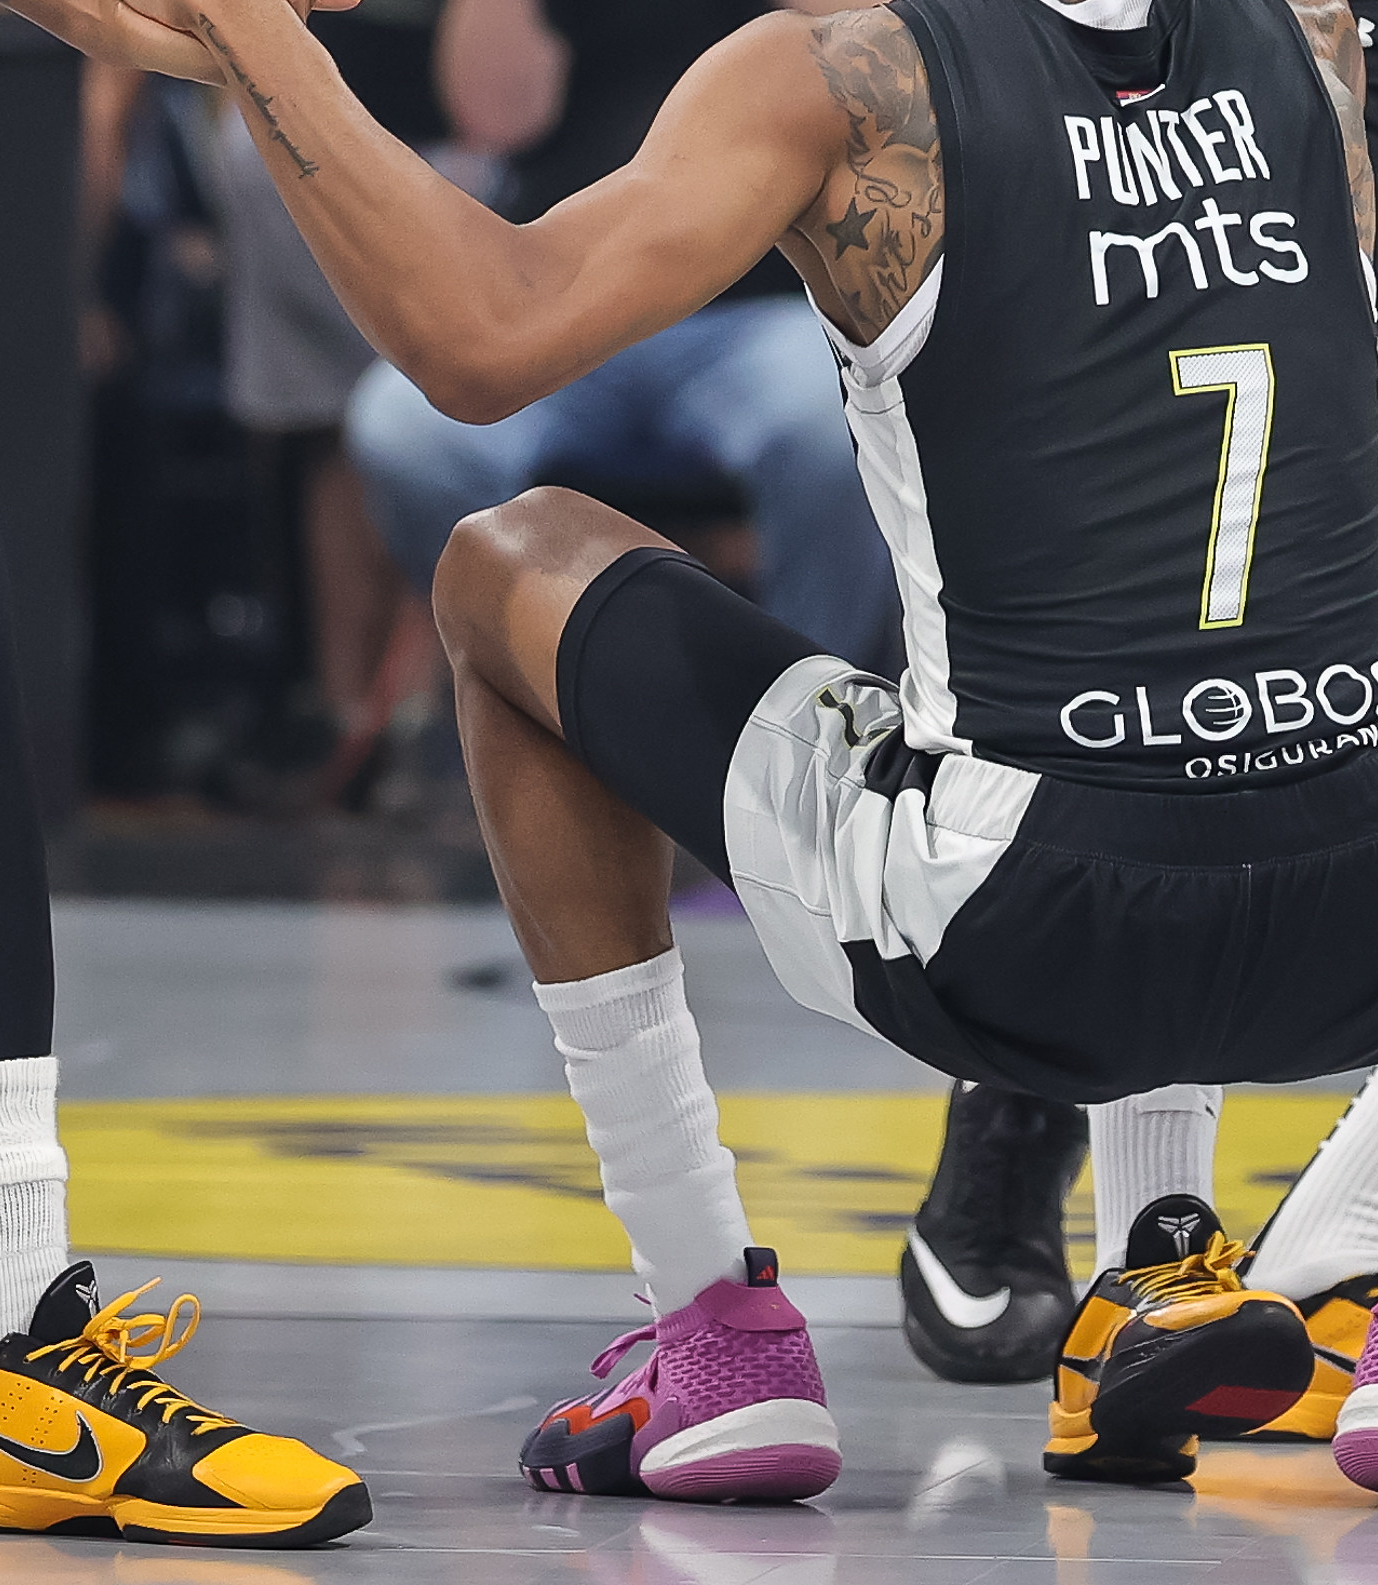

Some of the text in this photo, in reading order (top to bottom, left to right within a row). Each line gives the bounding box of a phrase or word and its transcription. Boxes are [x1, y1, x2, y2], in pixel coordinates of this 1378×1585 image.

[1063, 89, 1271, 207] PUNTER
[1089, 198, 1309, 306] mts
[1169, 342, 1276, 630] 7
